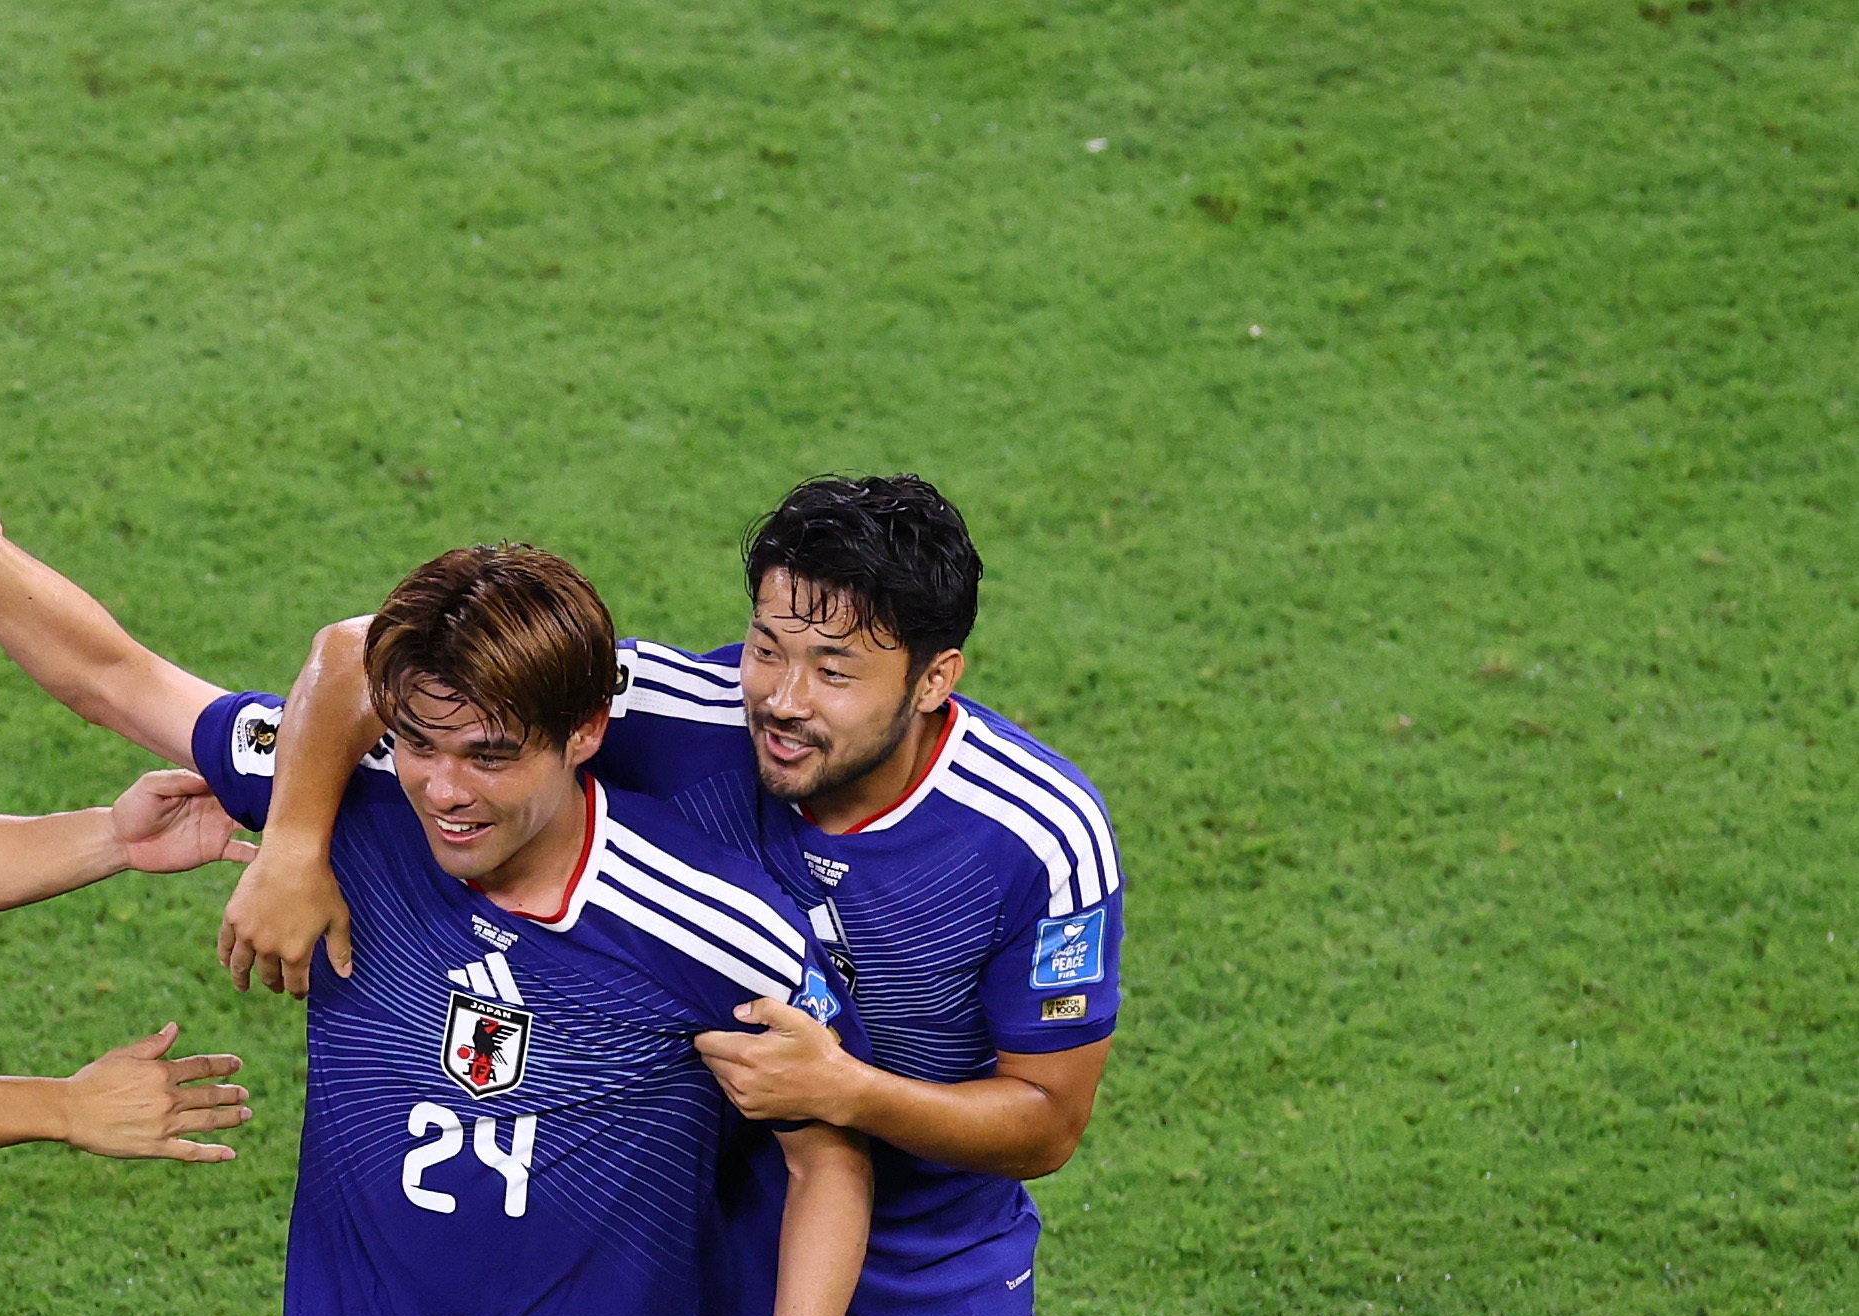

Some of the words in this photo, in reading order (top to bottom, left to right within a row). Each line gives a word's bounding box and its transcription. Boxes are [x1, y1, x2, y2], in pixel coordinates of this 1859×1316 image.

[1052, 954, 1086, 972] PEACE
[470, 1000, 512, 1020] JAPAN
[1056, 1005, 1081, 1014] 1000
[462, 1062, 498, 1083] JFA
[402, 1101, 538, 1218] 24
